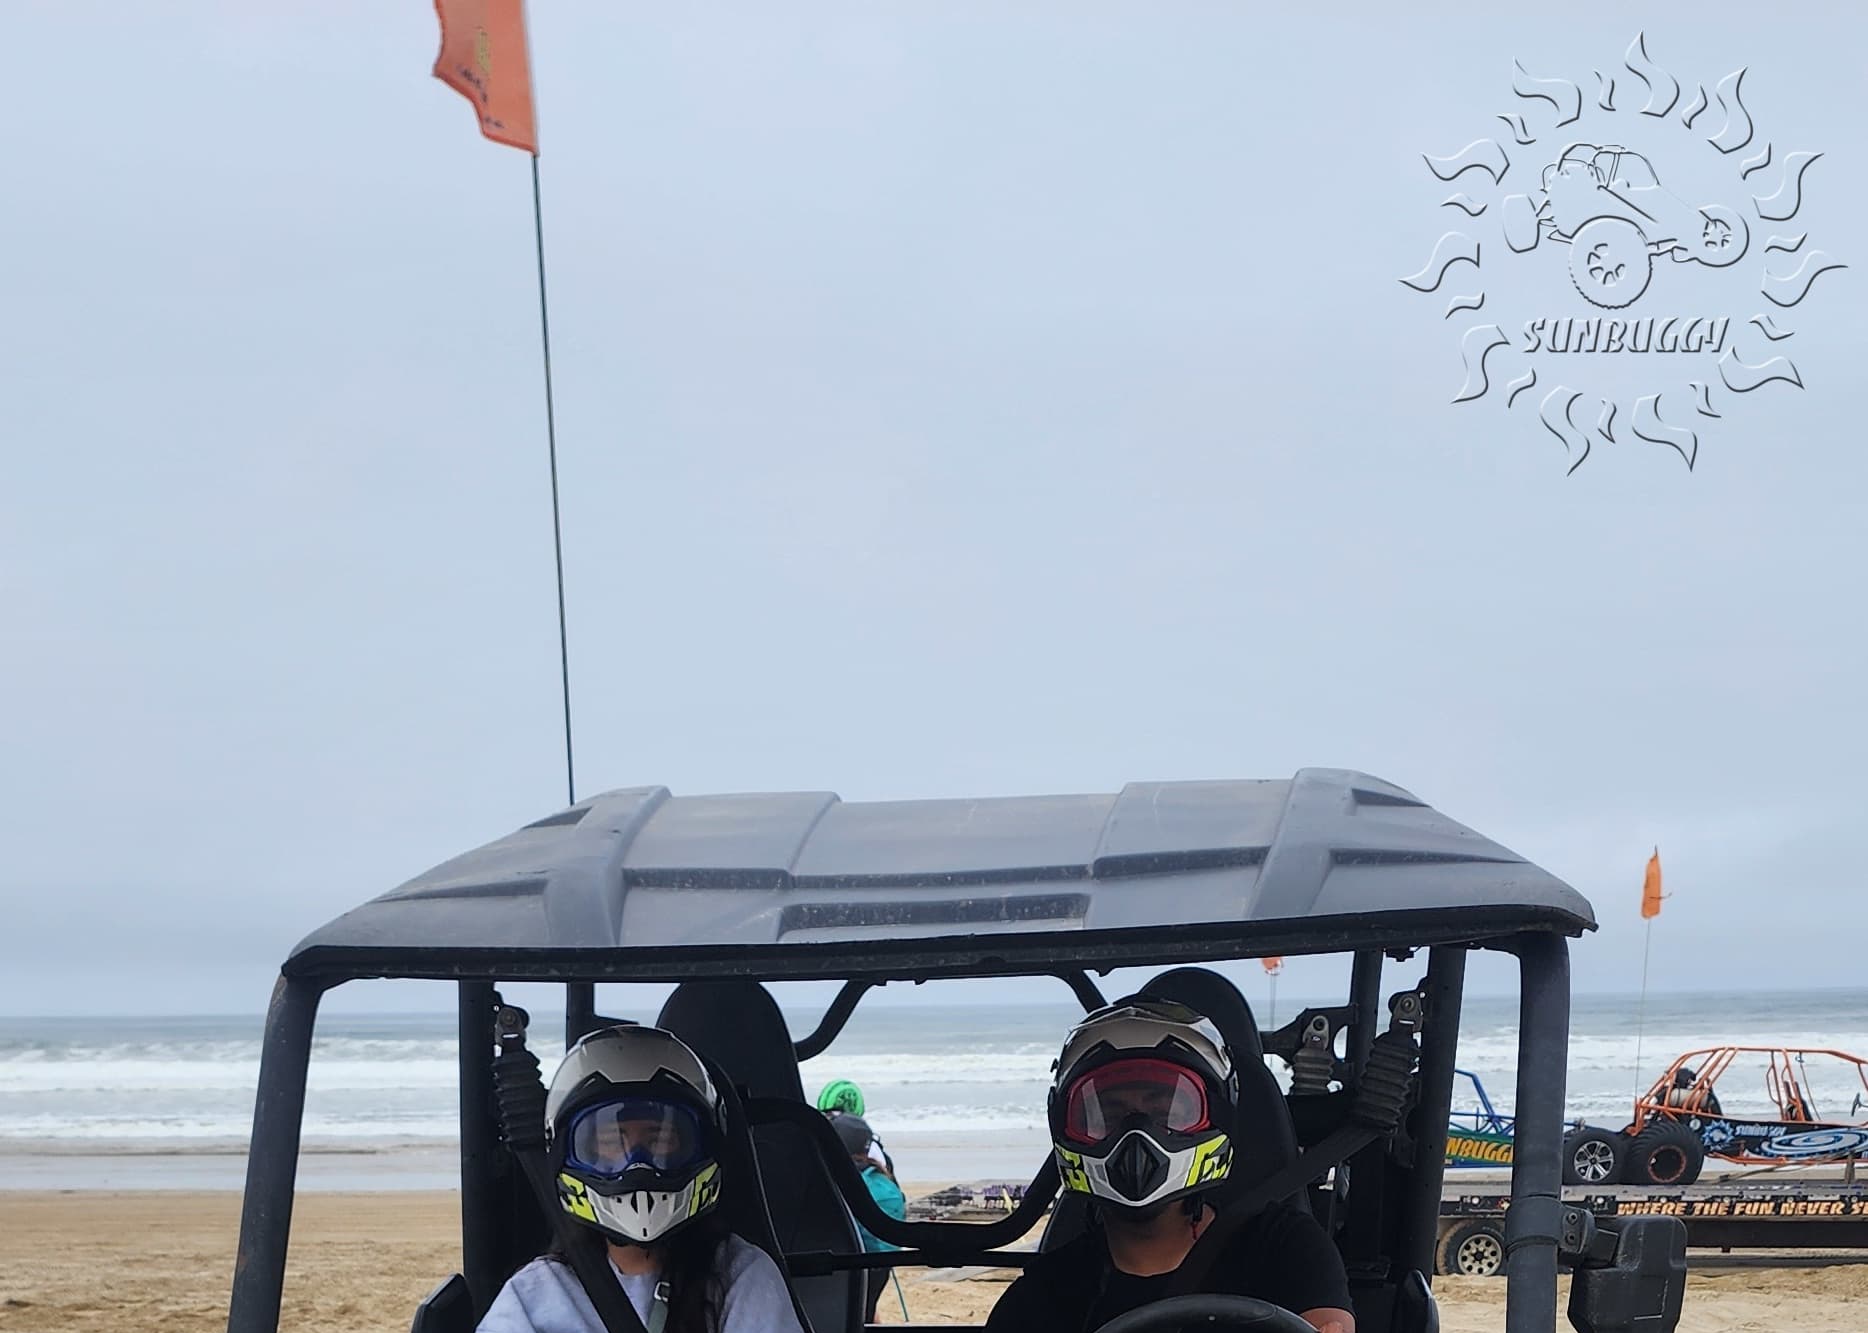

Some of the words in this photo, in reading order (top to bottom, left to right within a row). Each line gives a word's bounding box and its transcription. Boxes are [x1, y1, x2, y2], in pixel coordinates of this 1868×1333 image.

[1446, 1137, 1513, 1163] NBUGG
[1617, 1202, 1687, 1216] WHERE
[1692, 1202, 1730, 1216] THE
[1734, 1201, 1774, 1216] FUN
[1780, 1201, 1845, 1216] NEVER
